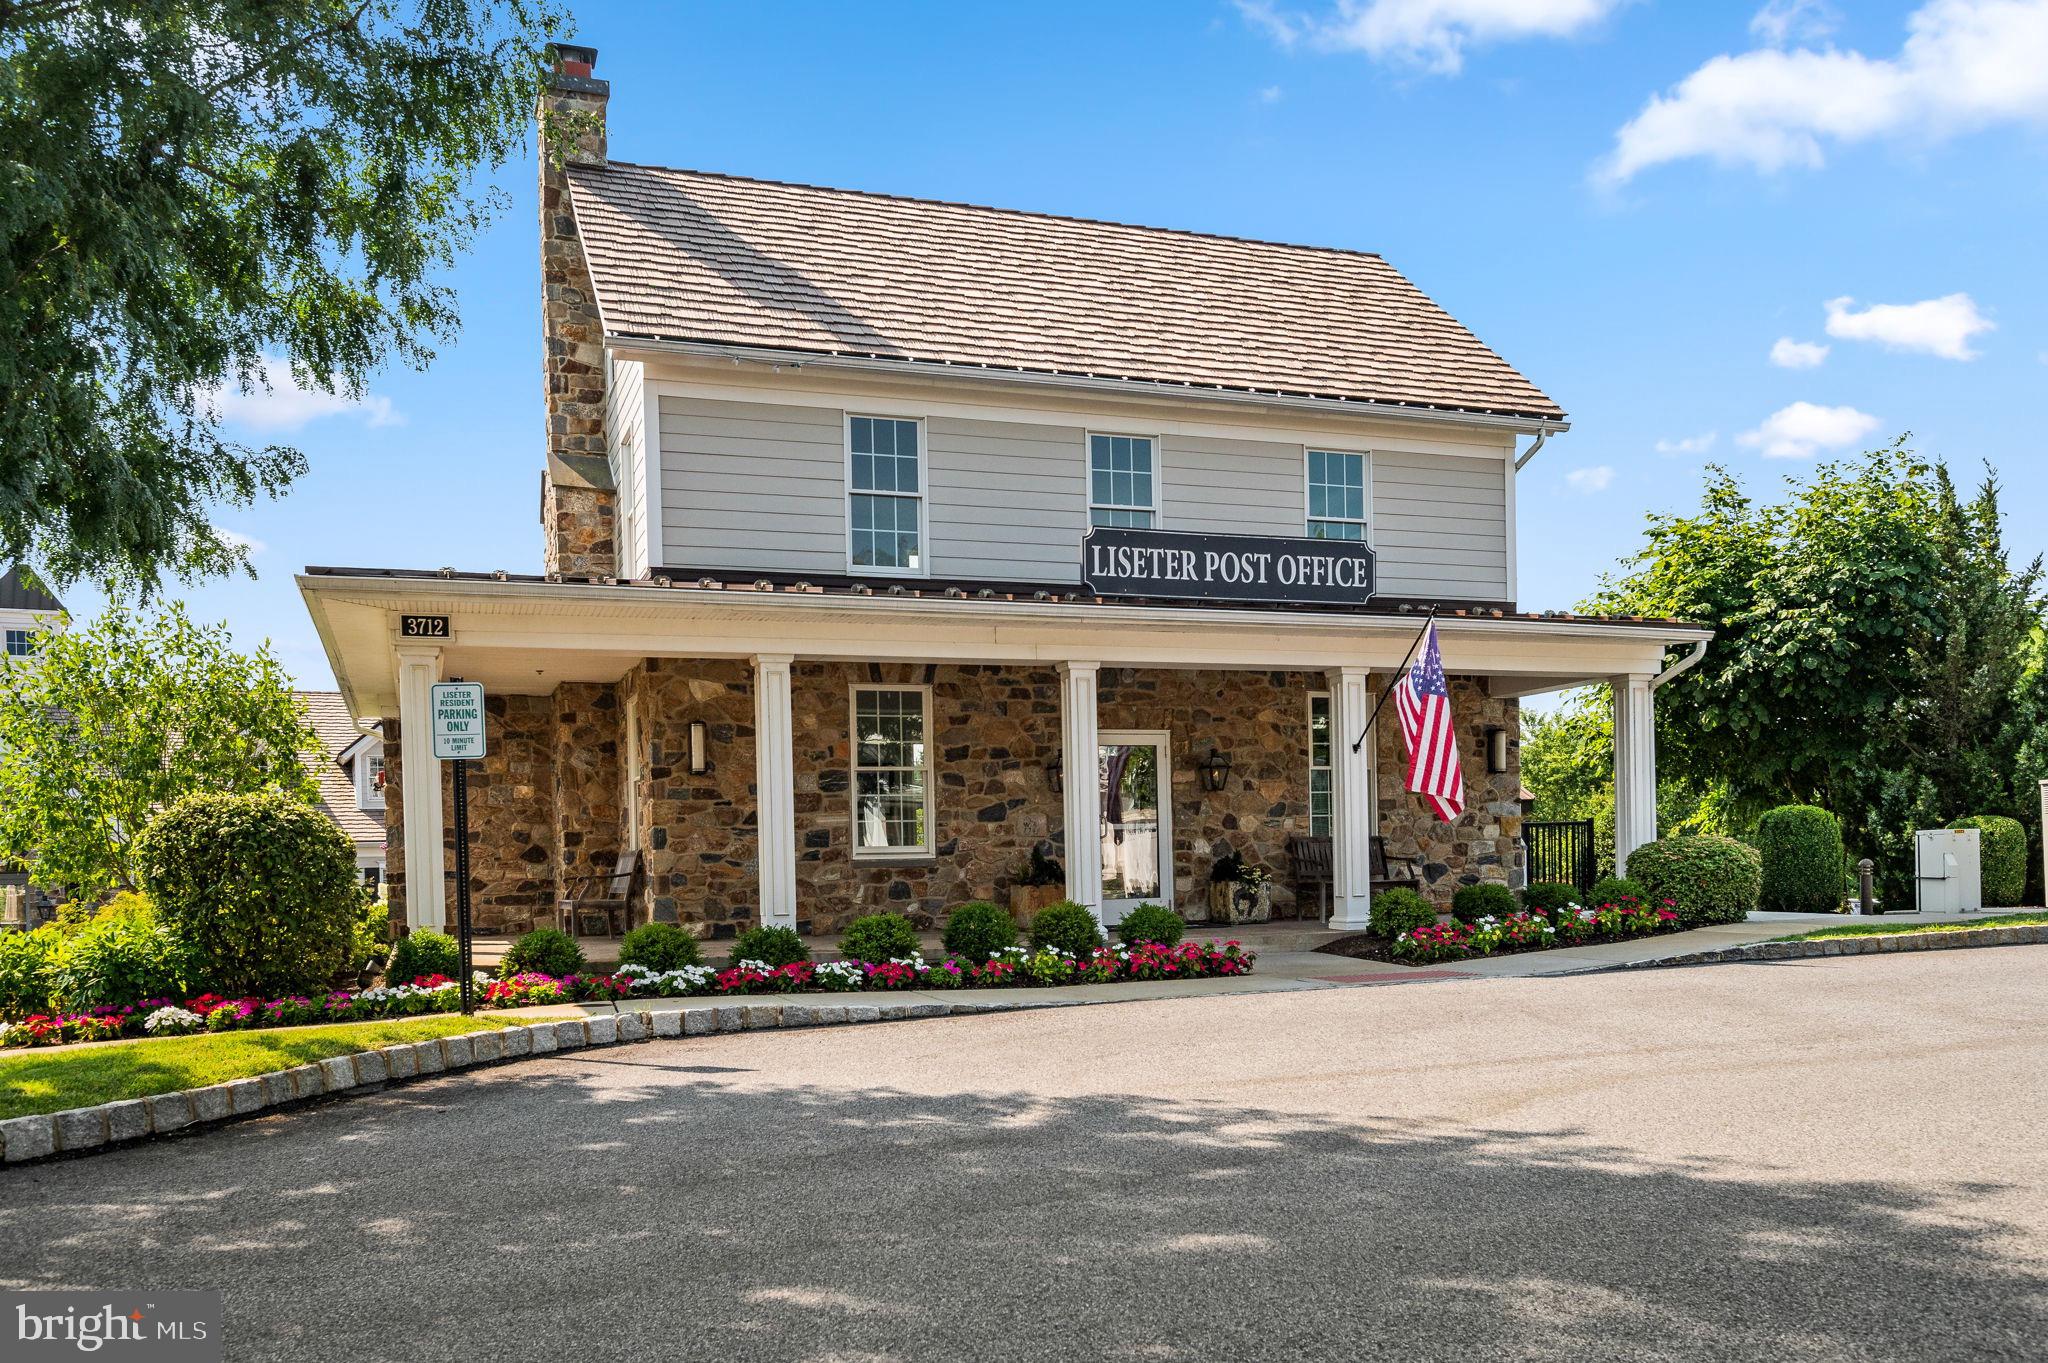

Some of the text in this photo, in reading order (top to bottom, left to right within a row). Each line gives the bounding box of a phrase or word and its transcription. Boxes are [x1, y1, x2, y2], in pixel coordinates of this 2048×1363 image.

[1091, 545, 1368, 588] LISETER POST OFFICE
[407, 618, 443, 636] 3712
[443, 691, 471, 699] LISETER
[440, 699, 474, 707] RESIDENT
[438, 708, 478, 720] PARKING
[446, 721, 469, 732] ONLY
